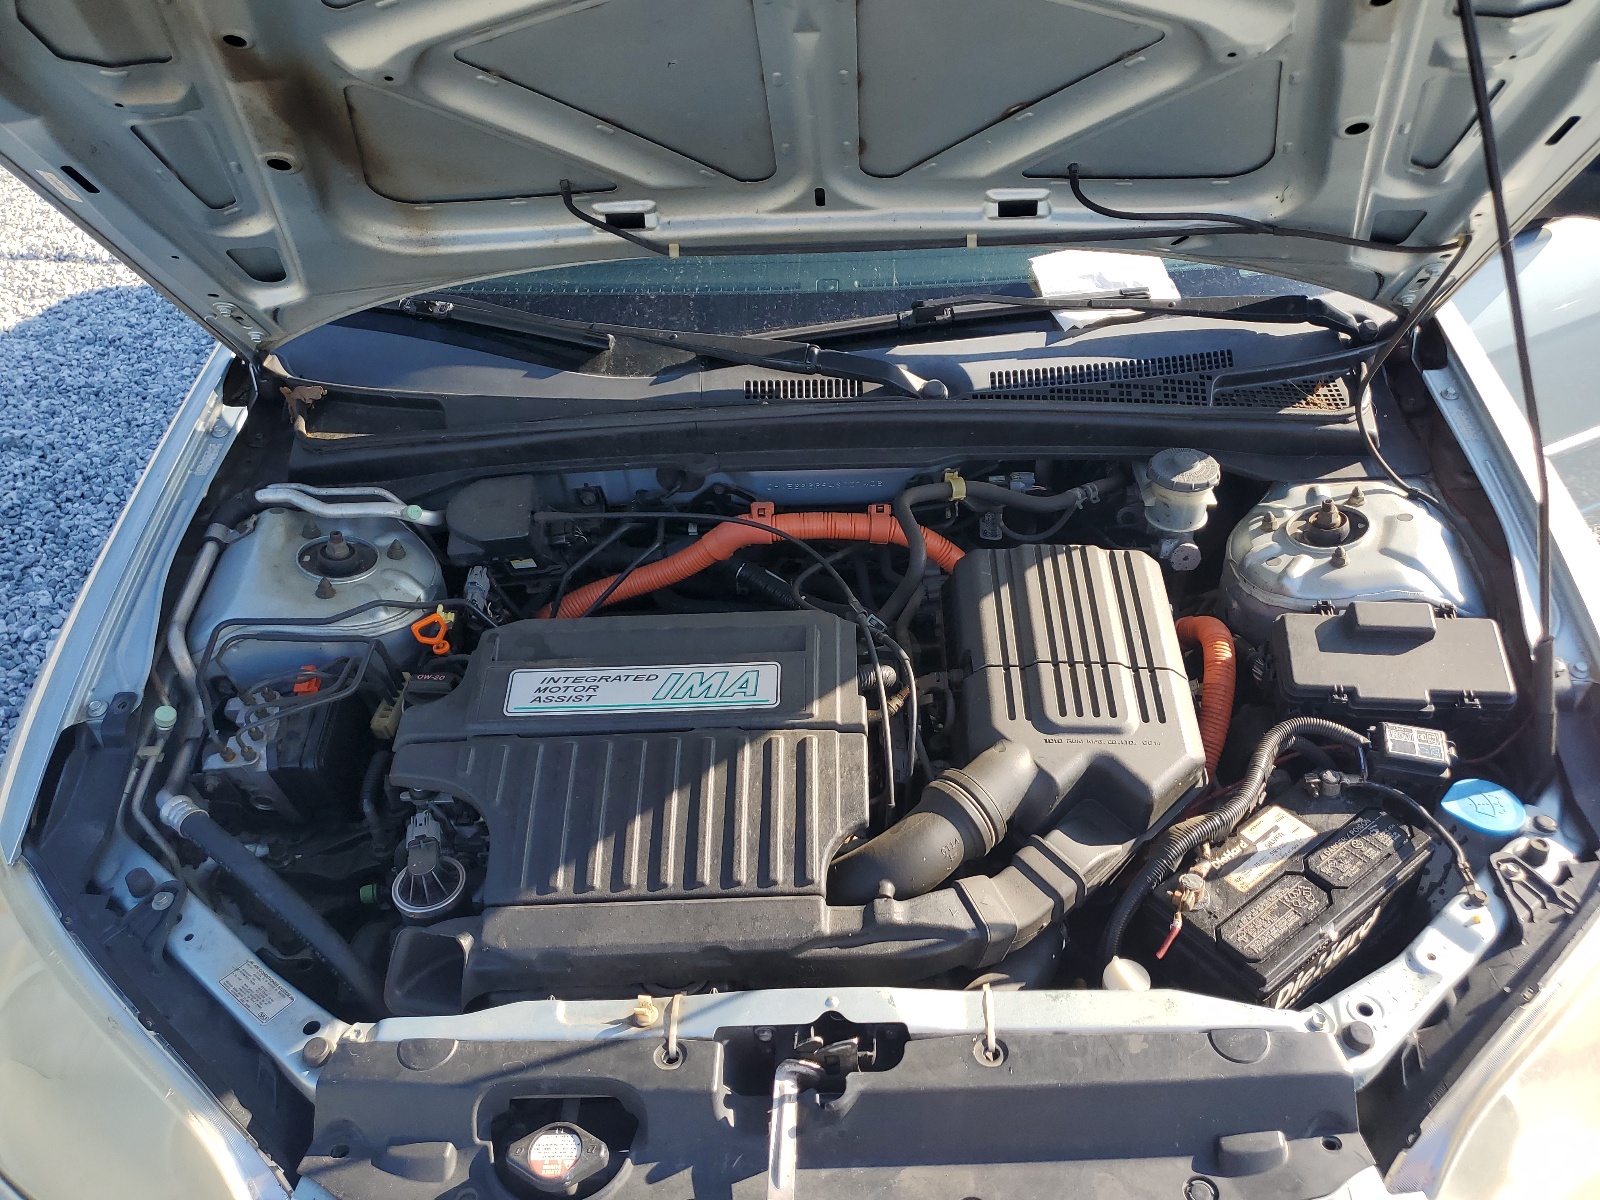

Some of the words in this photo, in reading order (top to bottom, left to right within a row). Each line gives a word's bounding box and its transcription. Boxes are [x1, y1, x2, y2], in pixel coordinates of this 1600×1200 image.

[529, 694, 598, 704] ASSIST
[533, 684, 600, 694] MOTOR
[540, 673, 659, 685] INTEGRATED
[652, 669, 759, 701] IMA
[1210, 840, 1248, 869] DieHard
[1275, 905, 1381, 1009] DieHard
